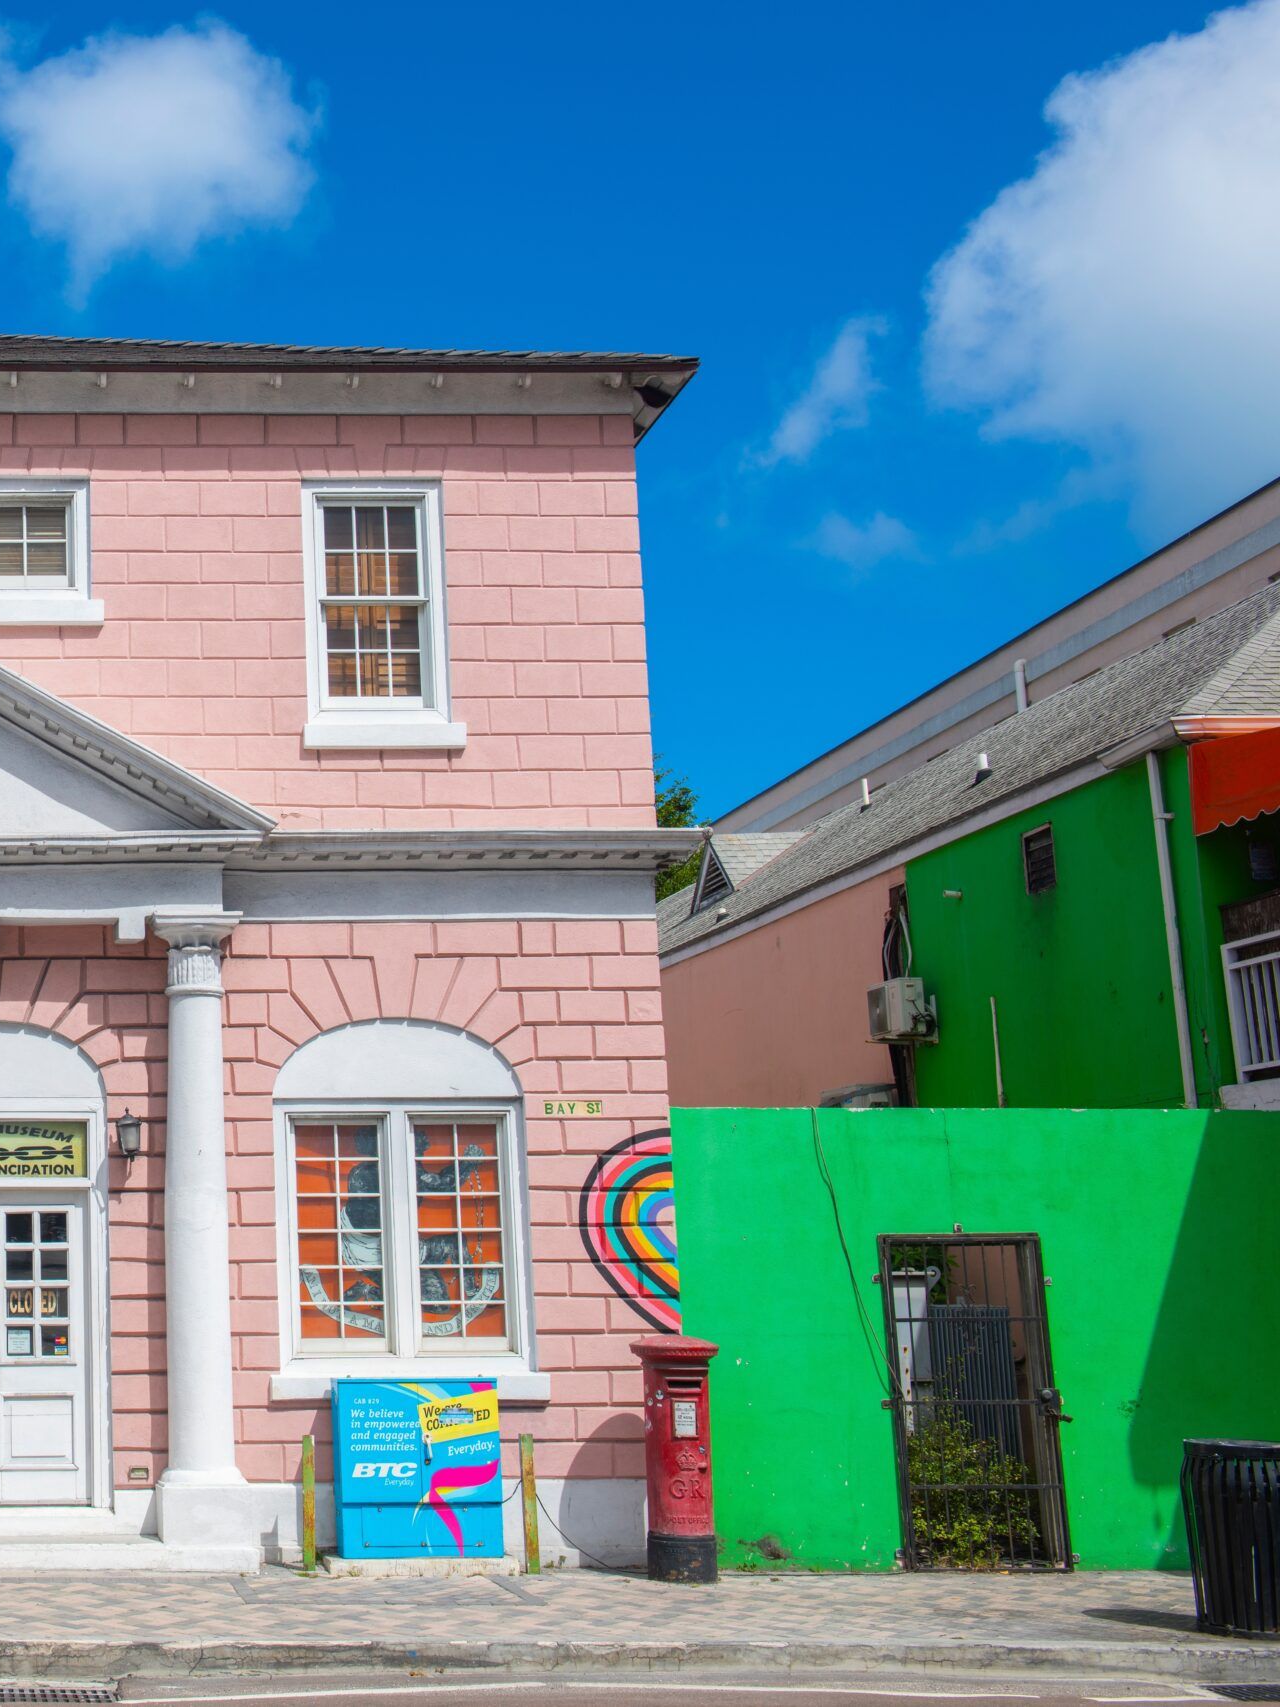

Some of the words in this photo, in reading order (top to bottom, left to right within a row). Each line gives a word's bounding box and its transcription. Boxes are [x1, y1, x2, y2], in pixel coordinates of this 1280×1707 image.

[544, 1103, 576, 1115] BAY
[9, 1290, 57, 1314] CLOED
[350, 1314, 358, 1326] A
[424, 1320, 453, 1334] AND
[350, 1408, 365, 1418] We
[368, 1408, 404, 1418] believe
[423, 1406, 440, 1418] We
[351, 1419, 360, 1428] in
[351, 1430, 370, 1440] and
[374, 1430, 416, 1442] engaged
[350, 1442, 418, 1452] communities.
[448, 1440, 495, 1456] Everyday.
[352, 1462, 418, 1478] BTC
[384, 1478, 414, 1488] Everyday
